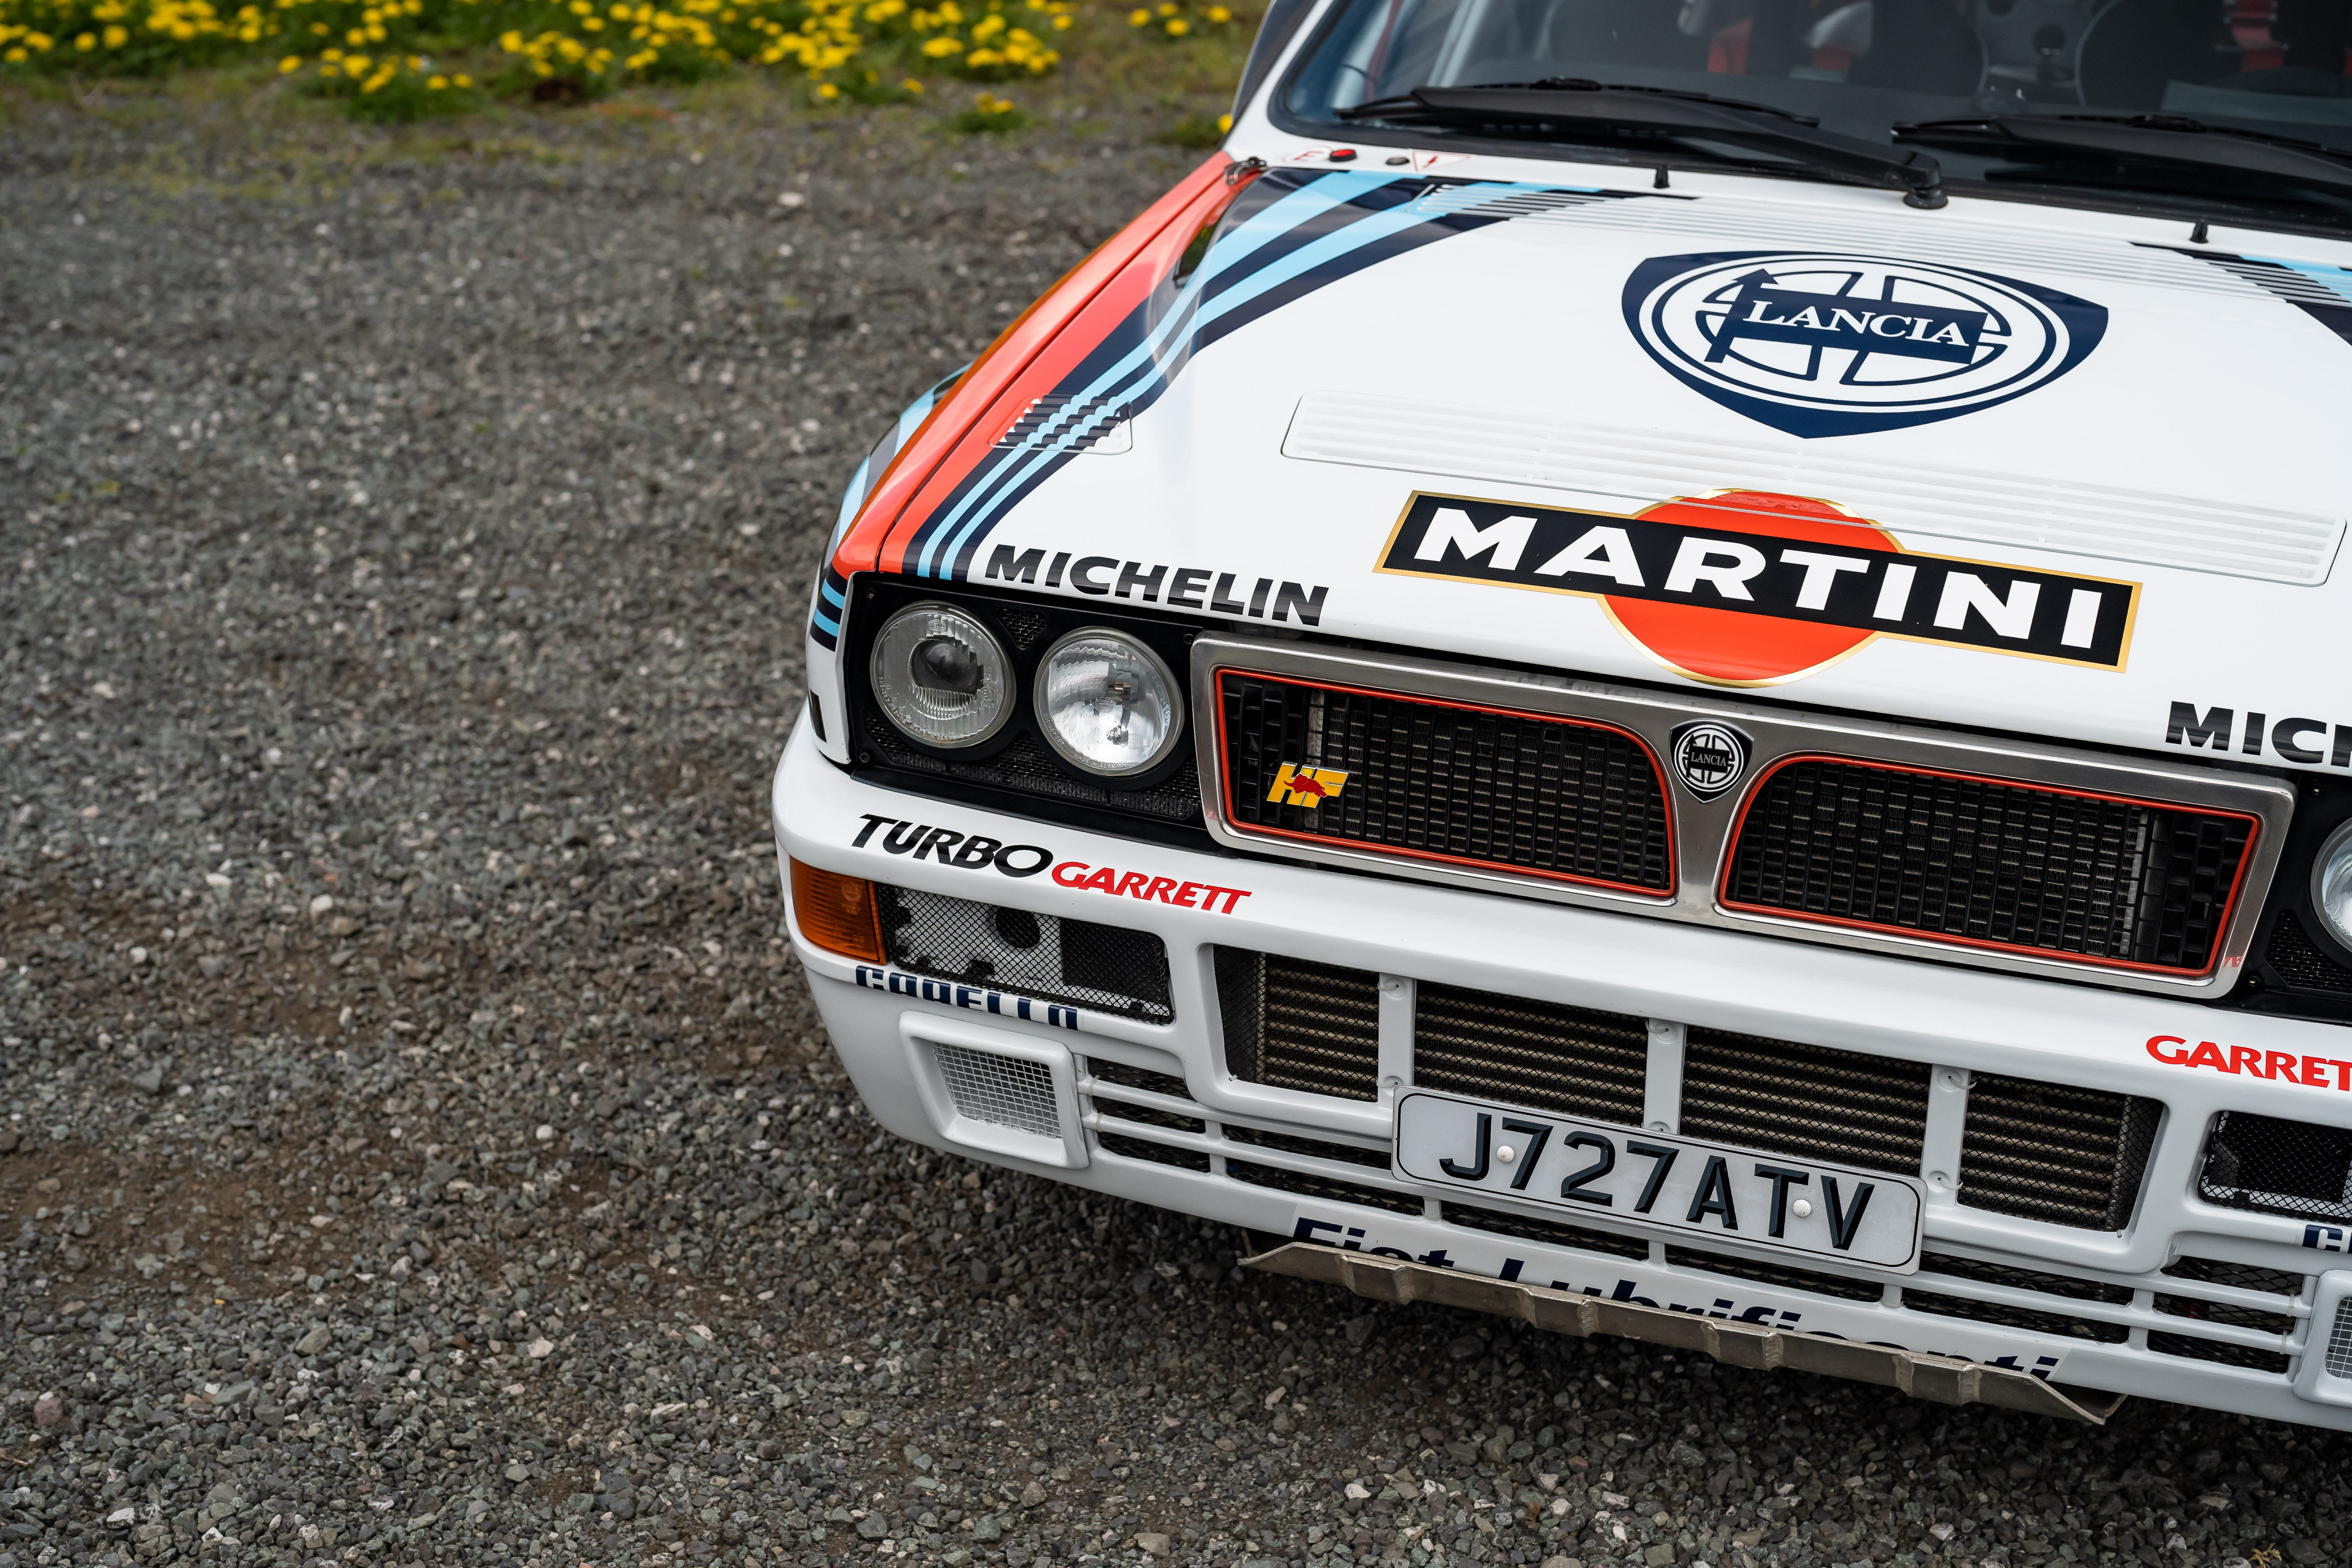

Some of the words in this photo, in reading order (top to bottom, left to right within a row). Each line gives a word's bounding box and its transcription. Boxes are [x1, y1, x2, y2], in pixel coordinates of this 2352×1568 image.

[1743, 300, 1969, 347] LANCIA
[985, 544, 1329, 627] MICHELIN
[1414, 506, 2102, 649] MARTINI
[1267, 761, 1350, 808] HF
[1691, 752, 1727, 767] LANCIA
[852, 814, 1053, 877] TURBO
[1051, 862, 1252, 915] GARRETT
[1439, 1112, 1875, 1250] J727ATV
